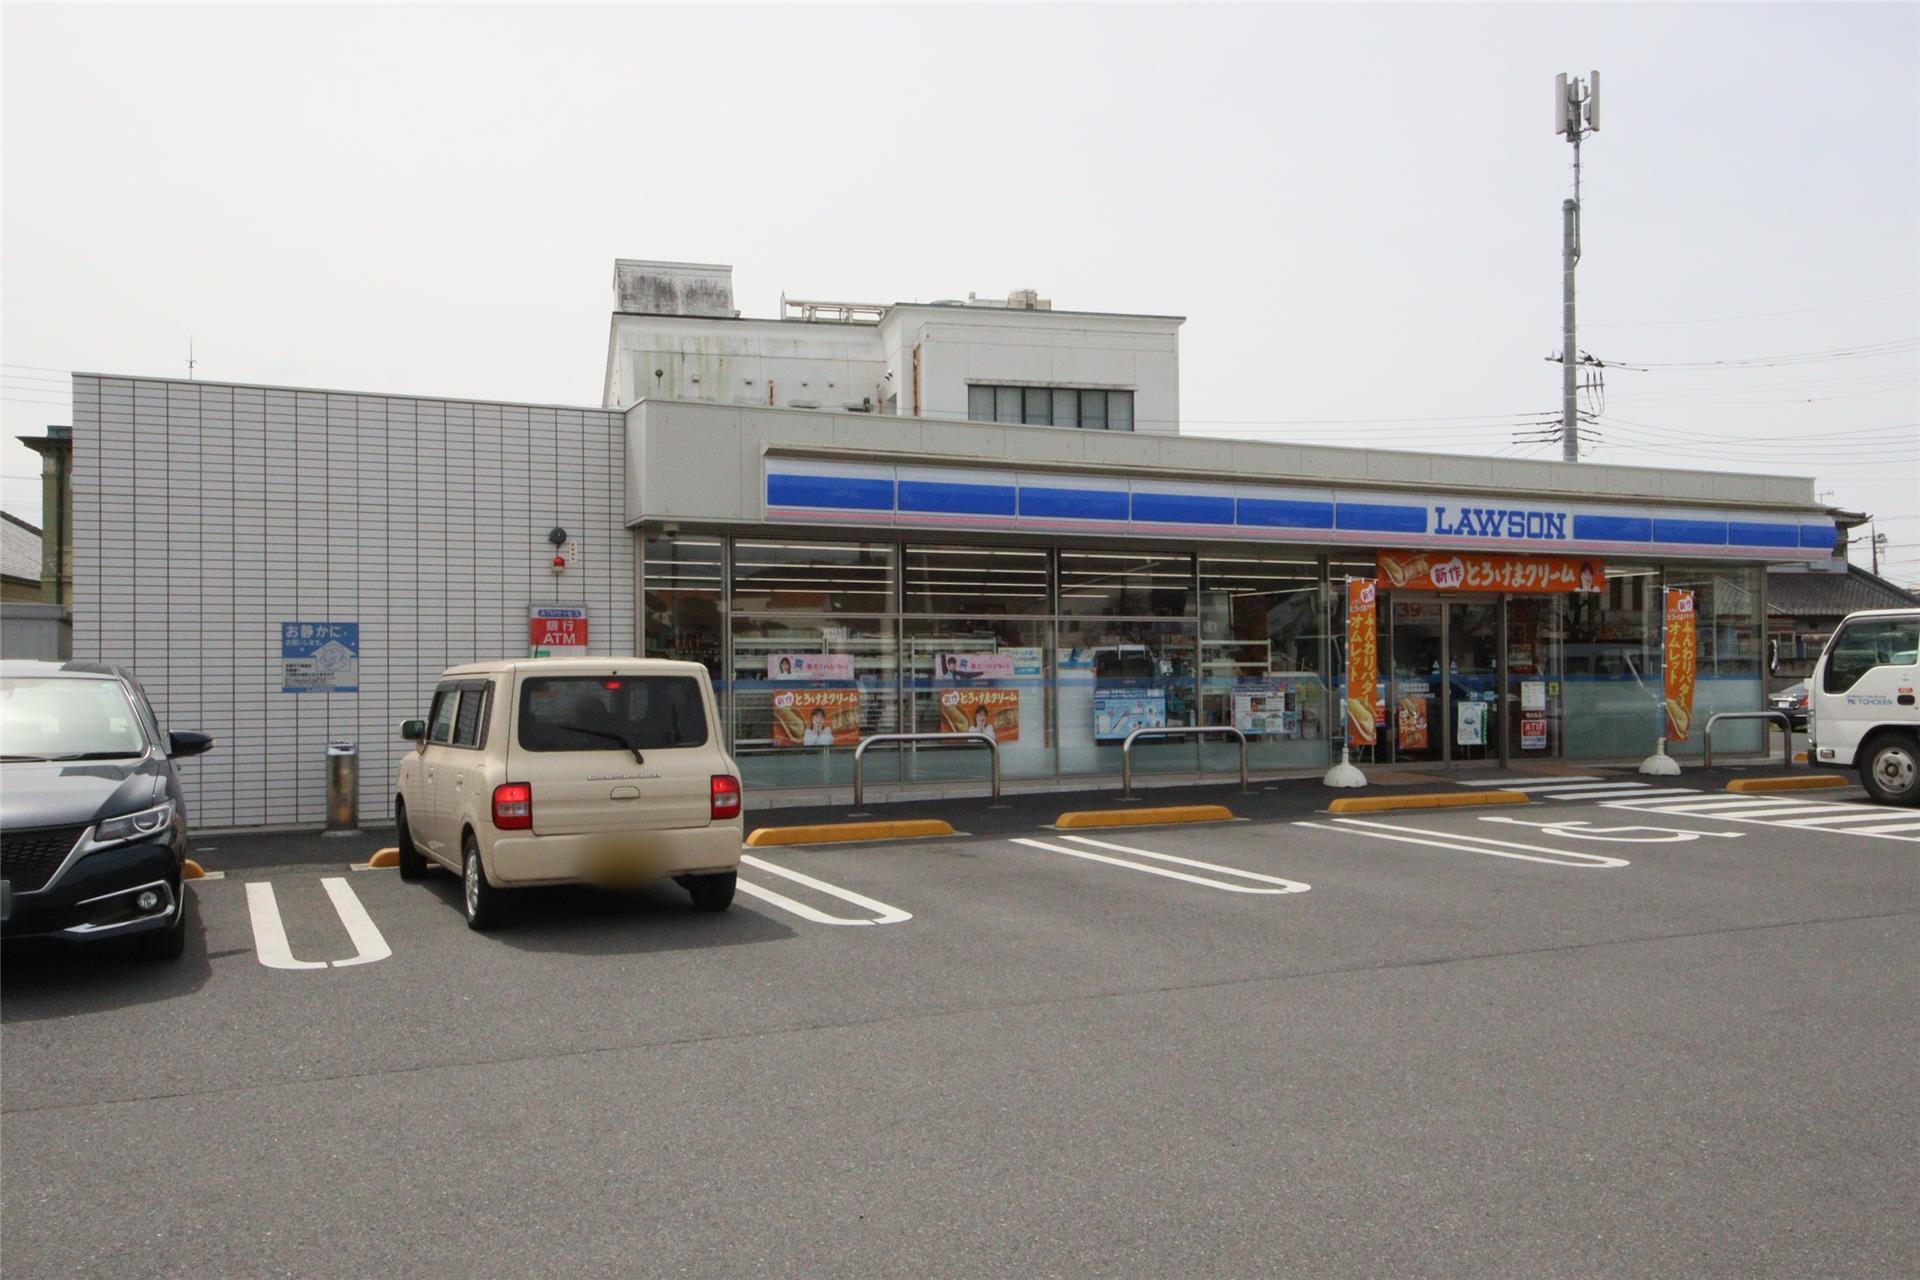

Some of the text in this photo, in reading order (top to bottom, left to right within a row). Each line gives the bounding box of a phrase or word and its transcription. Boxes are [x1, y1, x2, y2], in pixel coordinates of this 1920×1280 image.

[1435, 507, 1566, 539] LAWSON
[1434, 565, 1462, 584] 新作
[543, 633, 576, 644] ATM
[546, 621, 574, 632] 銀行
[1351, 614, 1363, 683] オムレット
[1360, 613, 1375, 705] ふんわりバター
[1669, 621, 1681, 685] オムレット
[1679, 621, 1693, 707] ふんわりバター
[1525, 723, 1543, 731] ATM
